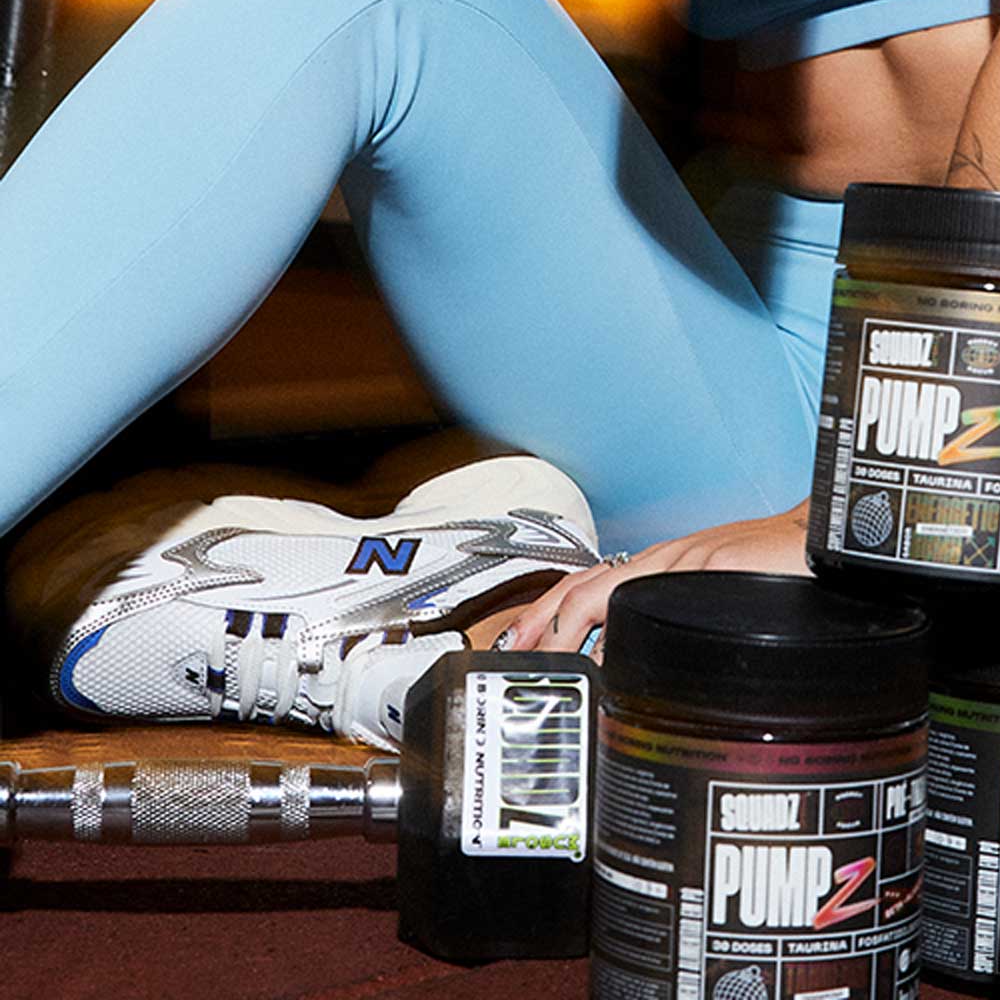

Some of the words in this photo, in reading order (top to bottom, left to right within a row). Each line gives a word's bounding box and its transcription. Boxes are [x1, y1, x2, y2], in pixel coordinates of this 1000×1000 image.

[939, 299, 995, 314] BORING
[912, 473, 973, 492] TAURINA
[787, 939, 848, 955] TAURINA
